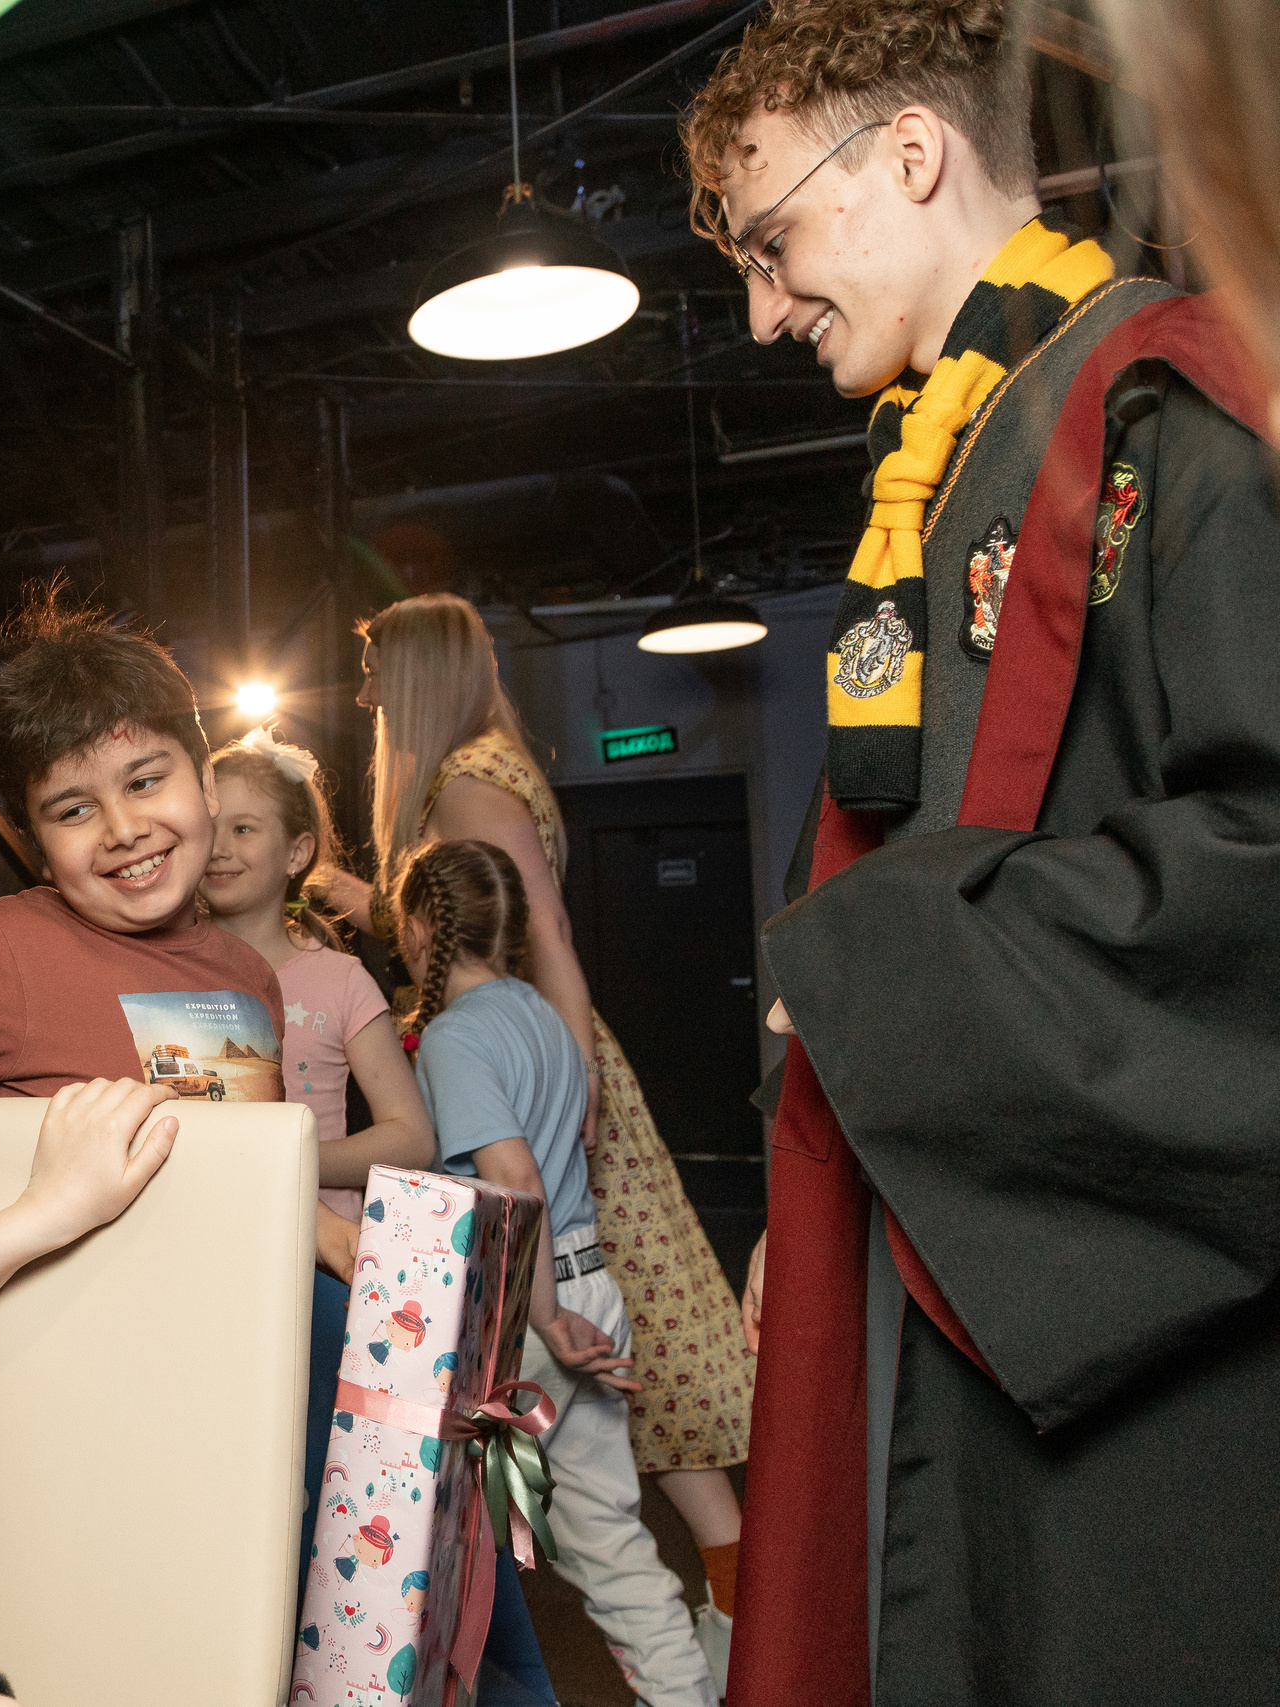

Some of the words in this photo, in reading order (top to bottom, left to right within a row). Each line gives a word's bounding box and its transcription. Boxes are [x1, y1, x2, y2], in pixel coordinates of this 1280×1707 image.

[974, 634, 994, 649] GRYF
[185, 1003, 236, 1011] EXPEDITION
[189, 1012, 238, 1021] EXPEDITION
[192, 1022, 240, 1031] EXPEDITION
